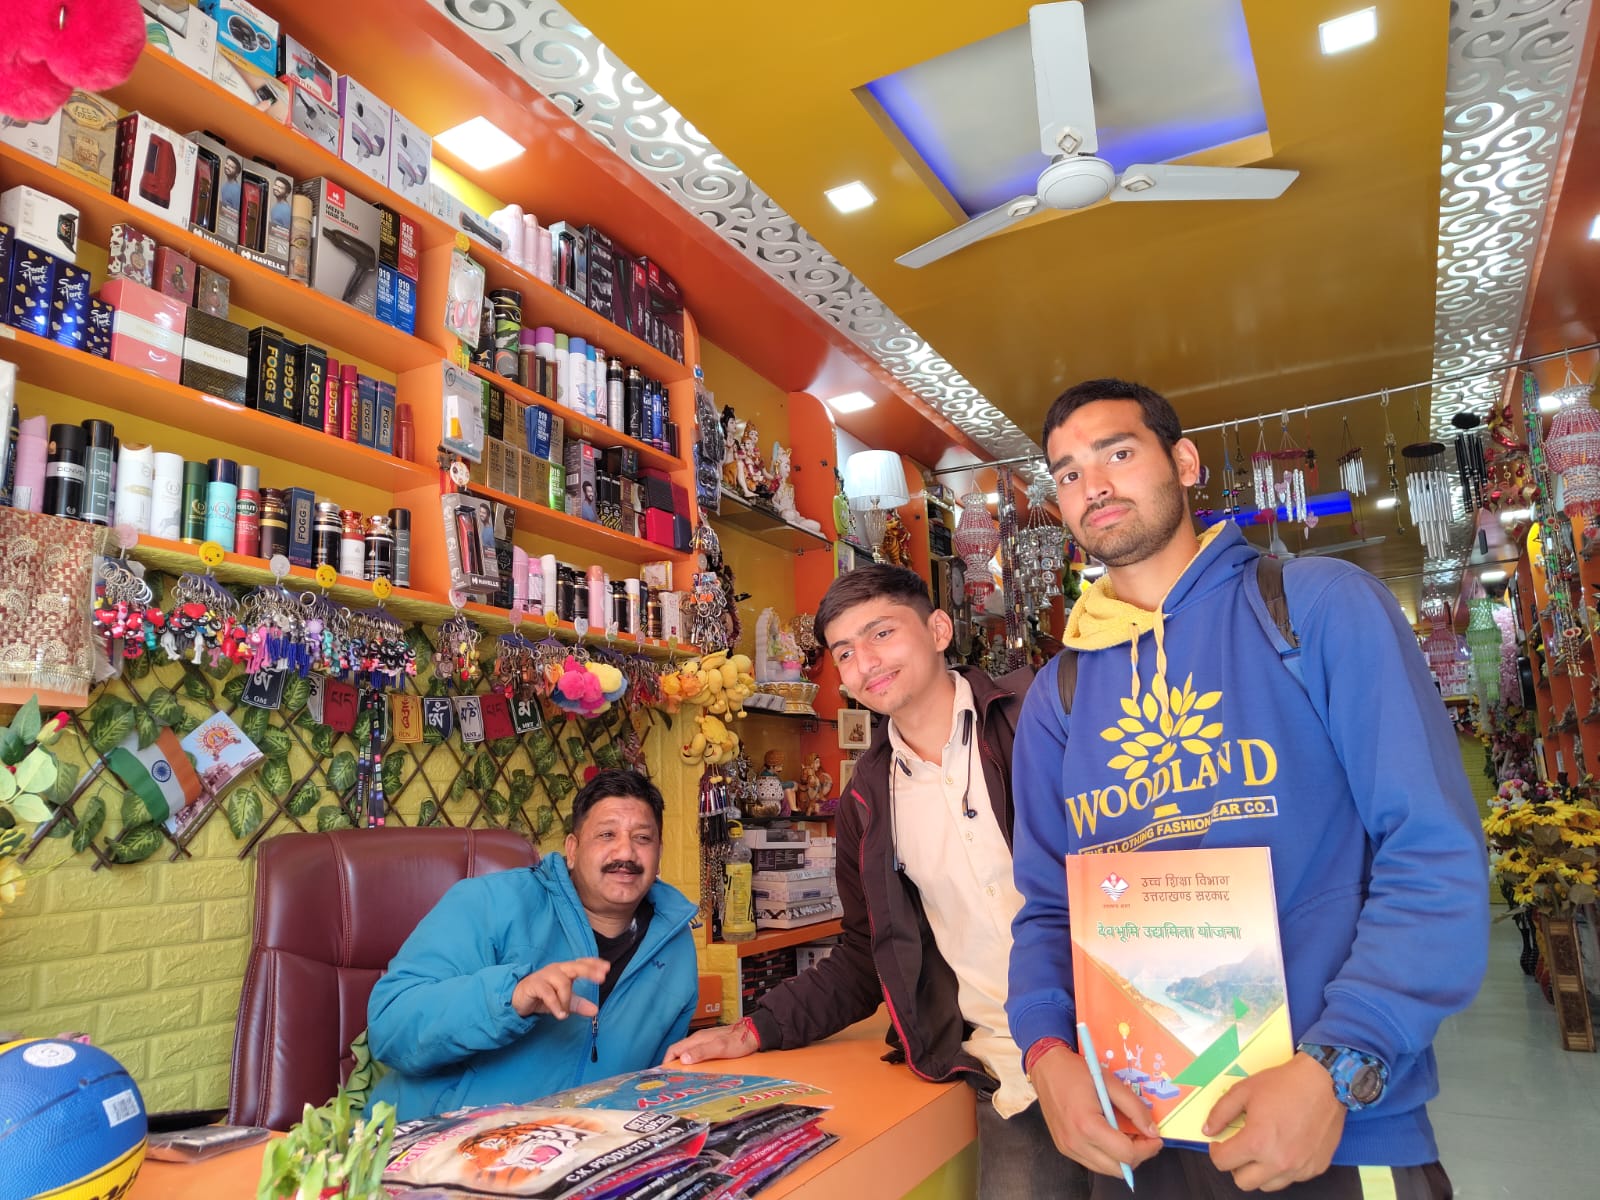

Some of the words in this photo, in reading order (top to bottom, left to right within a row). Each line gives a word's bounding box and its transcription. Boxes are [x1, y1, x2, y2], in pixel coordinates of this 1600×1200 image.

[325, 204, 345, 217] MEN'S
[325, 210, 340, 222] HAIR
[340, 217, 359, 231] DRYER
[402, 222, 413, 234] 919
[251, 254, 286, 272] HAVELLS
[378, 268, 391, 278] 919
[398, 278, 410, 290] 919
[265, 345, 279, 391] FOGG
[283, 363, 295, 410] FOGG
[308, 362, 322, 407] FOGG
[329, 389, 338, 424] FOGG
[364, 402, 372, 433] FOGG
[383, 409, 391, 439] FOGG
[298, 509, 307, 541] FOGG
[478, 579, 500, 588] HAVELLS
[1065, 738, 1278, 839] WOODLAND
[1106, 828, 1154, 855] CLOTHING
[1156, 815, 1212, 836] FASHION
[1212, 803, 1241, 818] EAR
[1243, 800, 1271, 814] CO.
[1140, 876, 1162, 888] उच्च
[1165, 873, 1192, 888] शिक्षा
[1195, 872, 1230, 887] विभाग
[1142, 890, 1192, 903] उत्तराखण्ड
[1195, 889, 1230, 902] सरकार
[1097, 921, 1140, 943] देवभूमि
[1197, 921, 1242, 940] योजना
[566, 1167, 595, 1183] C.K.
[591, 1139, 651, 1171] PRODUCTS
